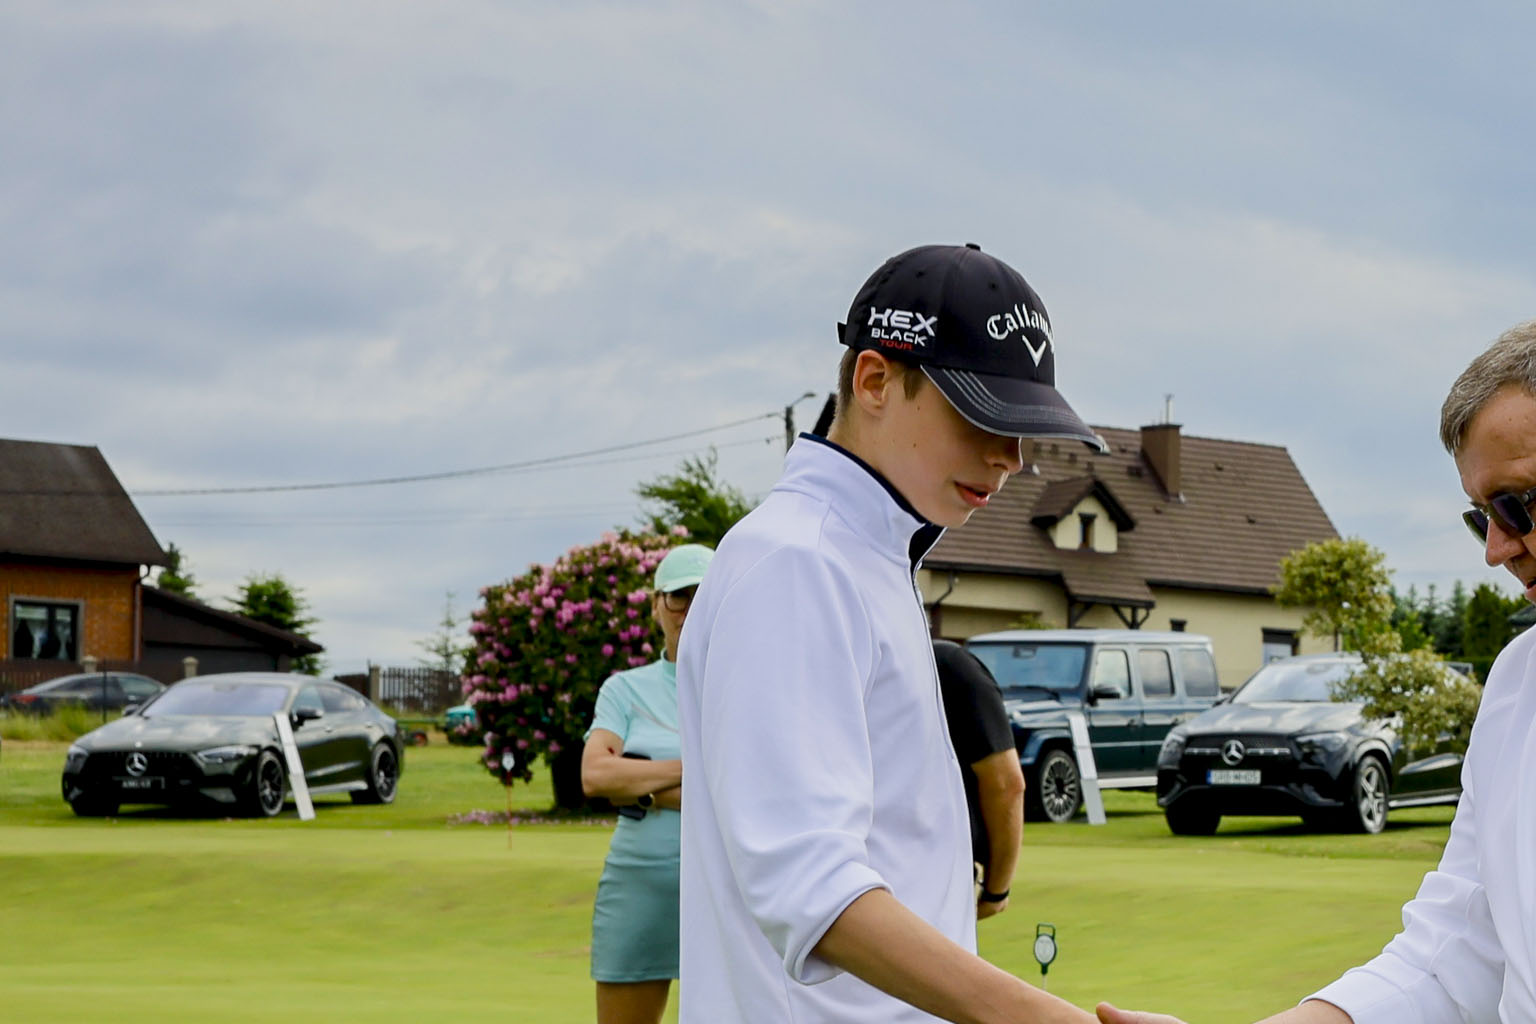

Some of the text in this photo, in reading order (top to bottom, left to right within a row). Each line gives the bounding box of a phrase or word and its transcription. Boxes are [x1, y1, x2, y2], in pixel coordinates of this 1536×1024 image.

[868, 306, 938, 337] HEX
[871, 327, 927, 347] BLACK
[880, 339, 914, 351] TOUR
